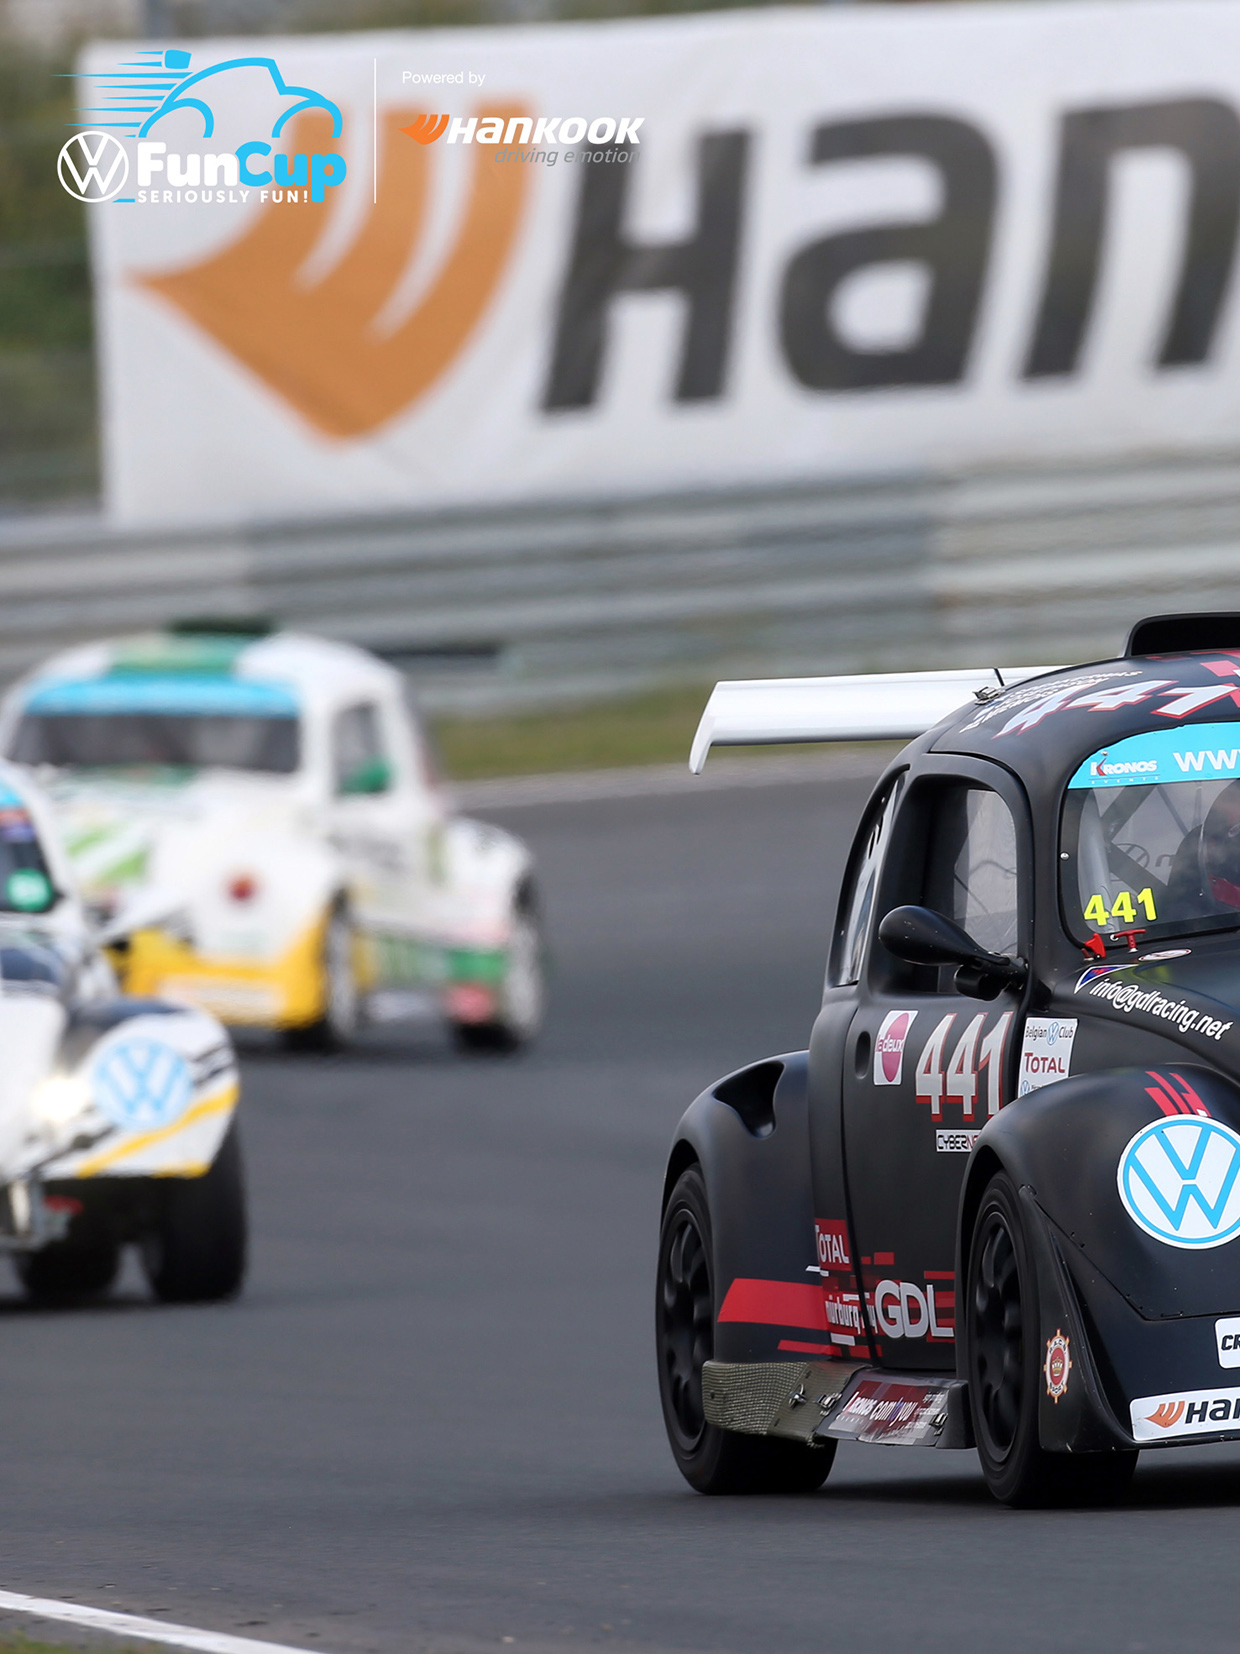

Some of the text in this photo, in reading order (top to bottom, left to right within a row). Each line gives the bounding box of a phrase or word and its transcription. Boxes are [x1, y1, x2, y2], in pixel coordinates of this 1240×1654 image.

[1090, 758, 1158, 776] KRONOS
[1084, 888, 1157, 926] 441
[1089, 977, 1234, 1040] info@gdlracing.net
[1025, 1026, 1047, 1041] Belgian
[1058, 1026, 1074, 1039] Club
[915, 1011, 1014, 1122] 441
[1024, 1052, 1066, 1073] TOTAL
[875, 1280, 954, 1339] GDL
